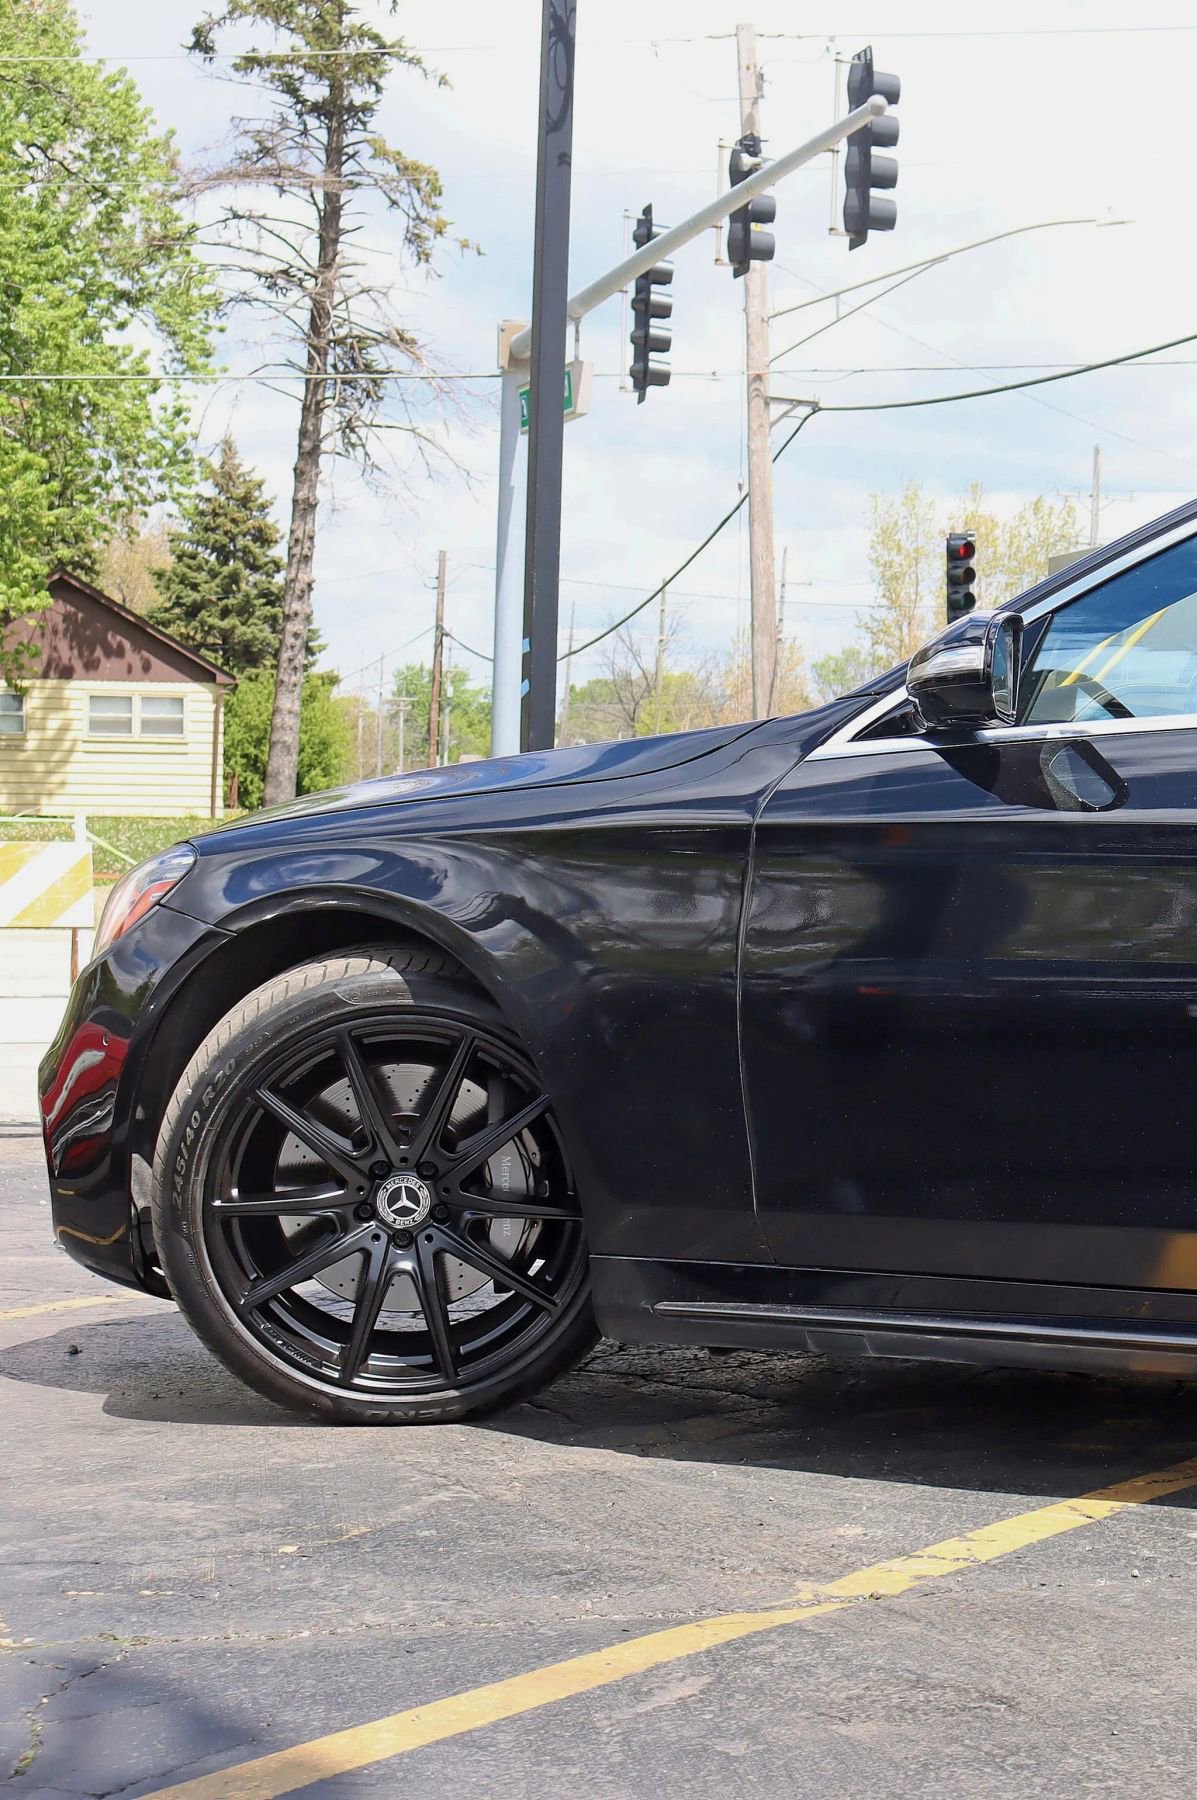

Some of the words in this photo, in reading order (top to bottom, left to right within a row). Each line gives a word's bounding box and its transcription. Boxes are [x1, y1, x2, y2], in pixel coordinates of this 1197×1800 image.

[172, 1110, 200, 1209] 245/40
[203, 1058, 236, 1107] R20
[386, 1178, 420, 1189] MERCEDES
